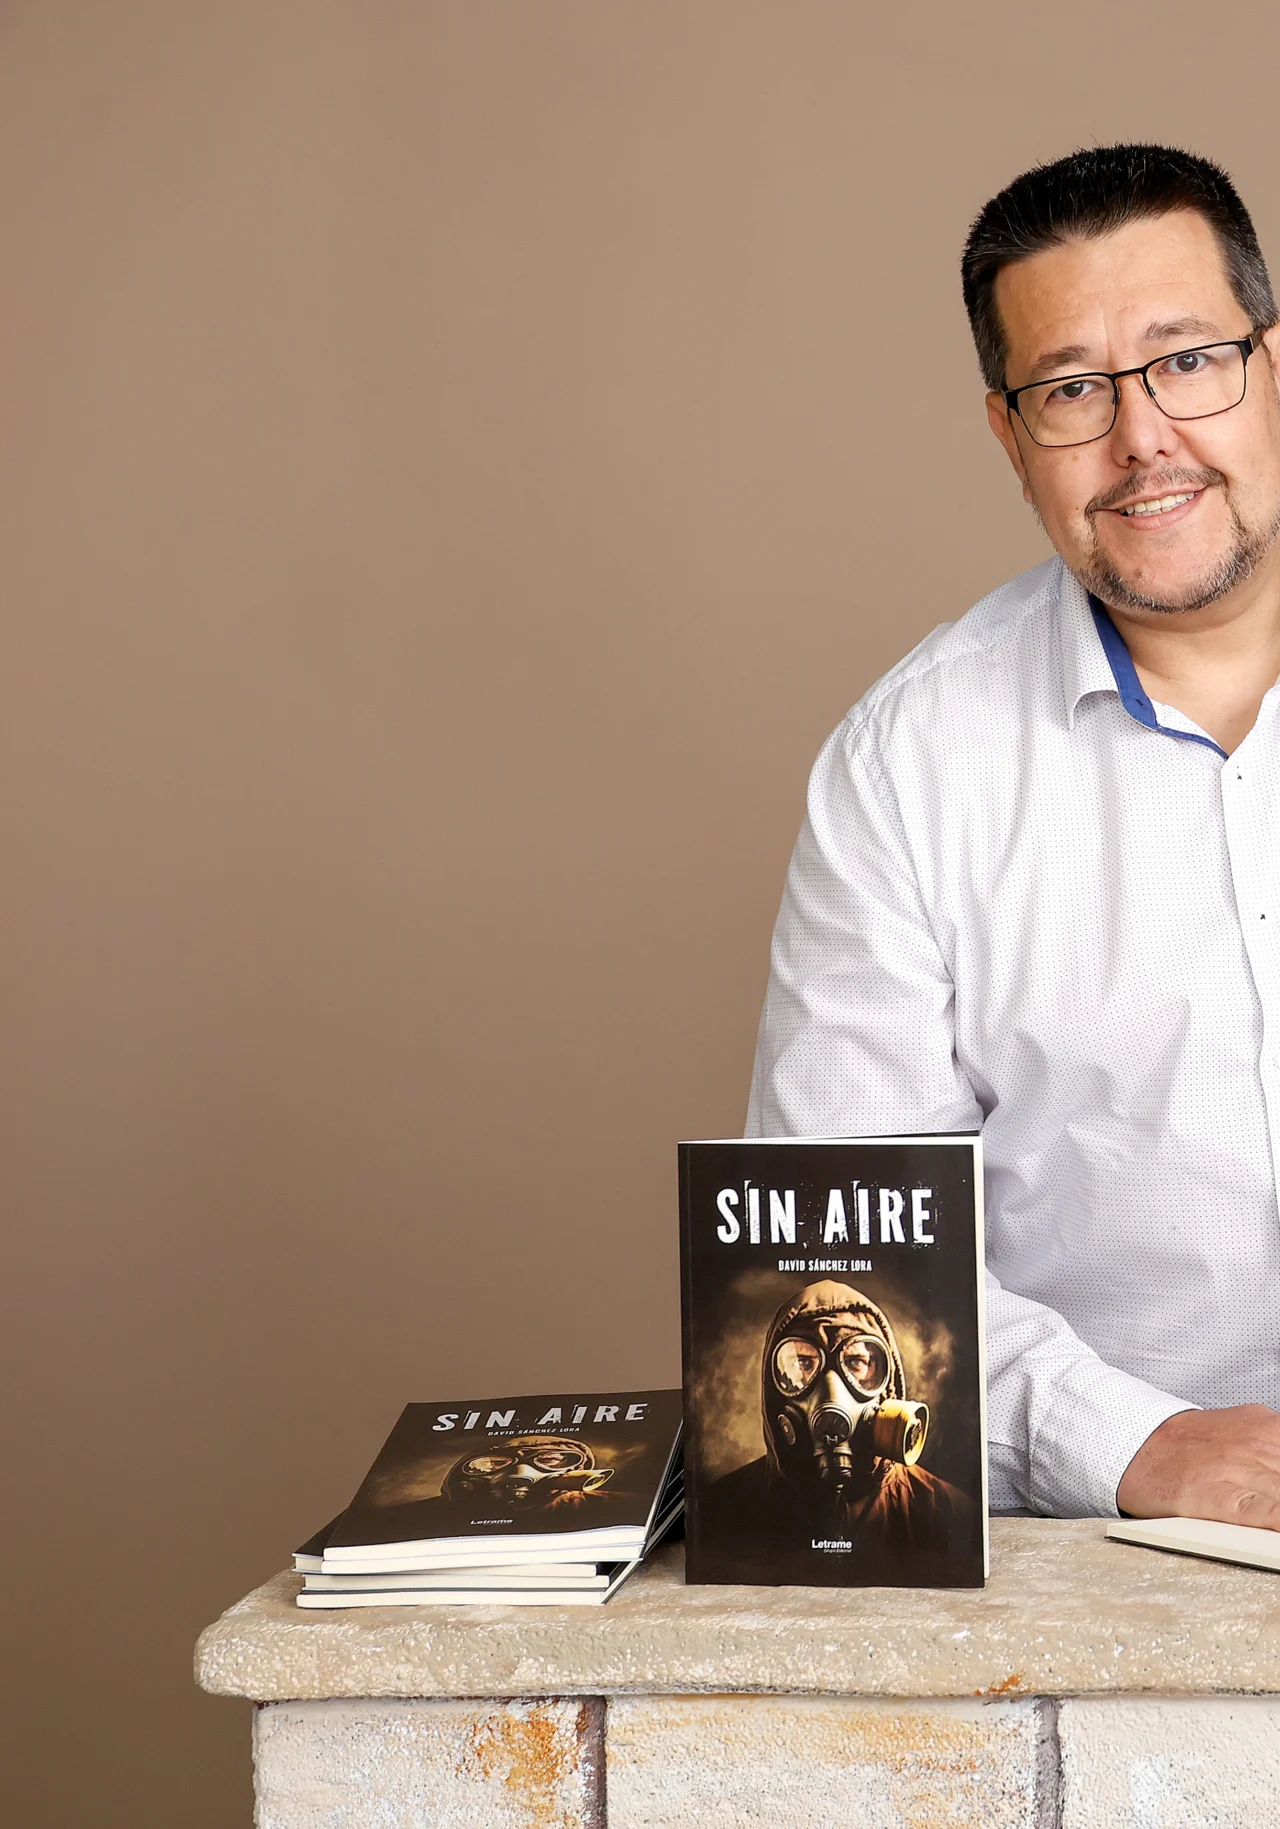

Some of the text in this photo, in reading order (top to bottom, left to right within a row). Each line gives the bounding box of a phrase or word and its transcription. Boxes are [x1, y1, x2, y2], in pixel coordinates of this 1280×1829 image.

[716, 1180, 935, 1245] SIN AIRE
[778, 1258, 873, 1272] DAVID SÁNCHEZ LORA
[432, 1403, 648, 1431] SIN AIRE
[811, 1539, 853, 1549] Letrame
